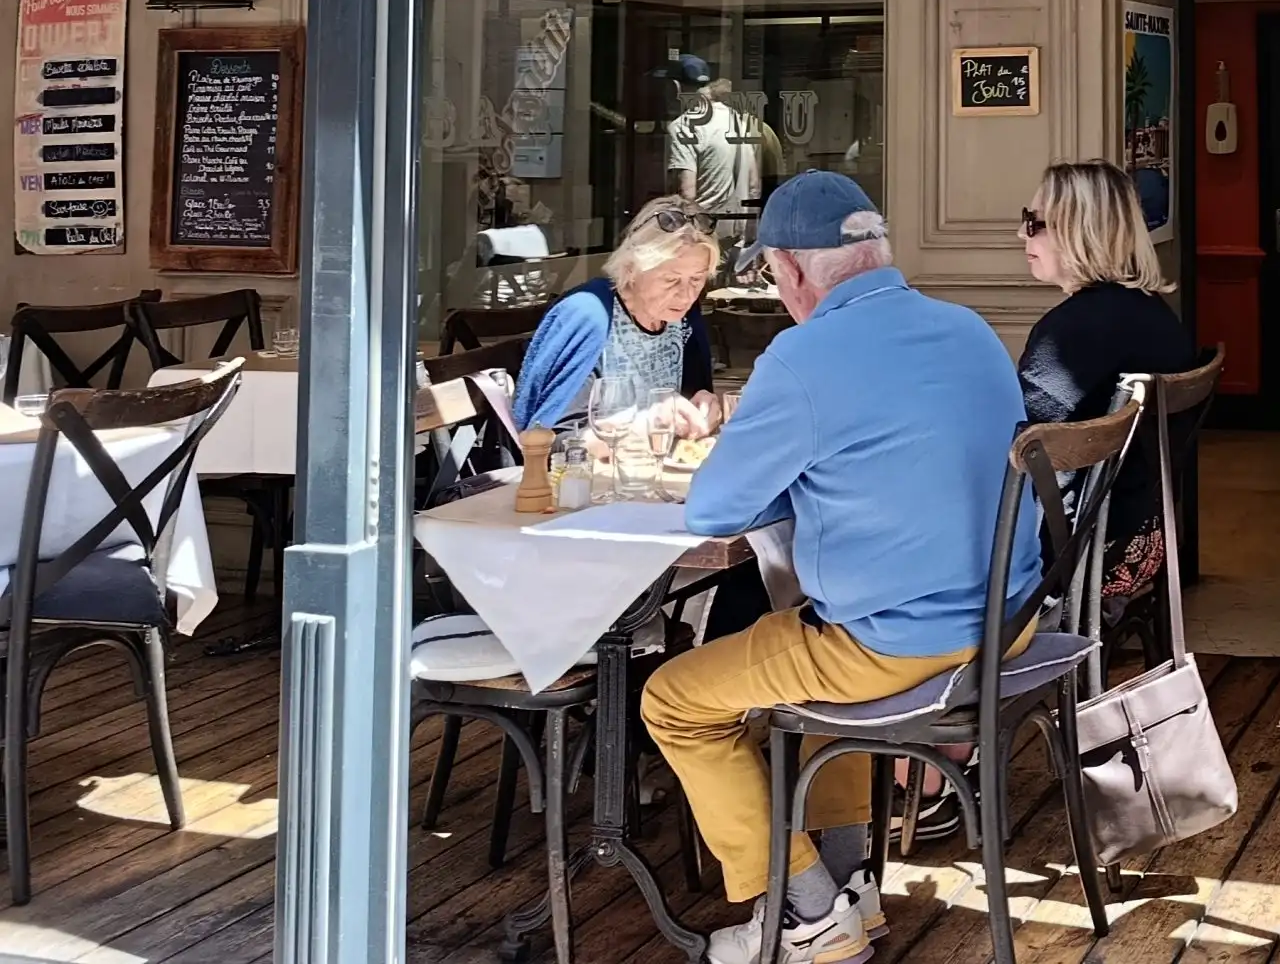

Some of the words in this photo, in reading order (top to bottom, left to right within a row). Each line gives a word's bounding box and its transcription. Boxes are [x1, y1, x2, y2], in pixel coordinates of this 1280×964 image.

[65, 4, 86, 16] NOUS
[962, 59, 993, 78] PLAT
[972, 79, 1013, 104] Jour
[676, 90, 819, 145] PMU
[20, 174, 43, 192] VEN
